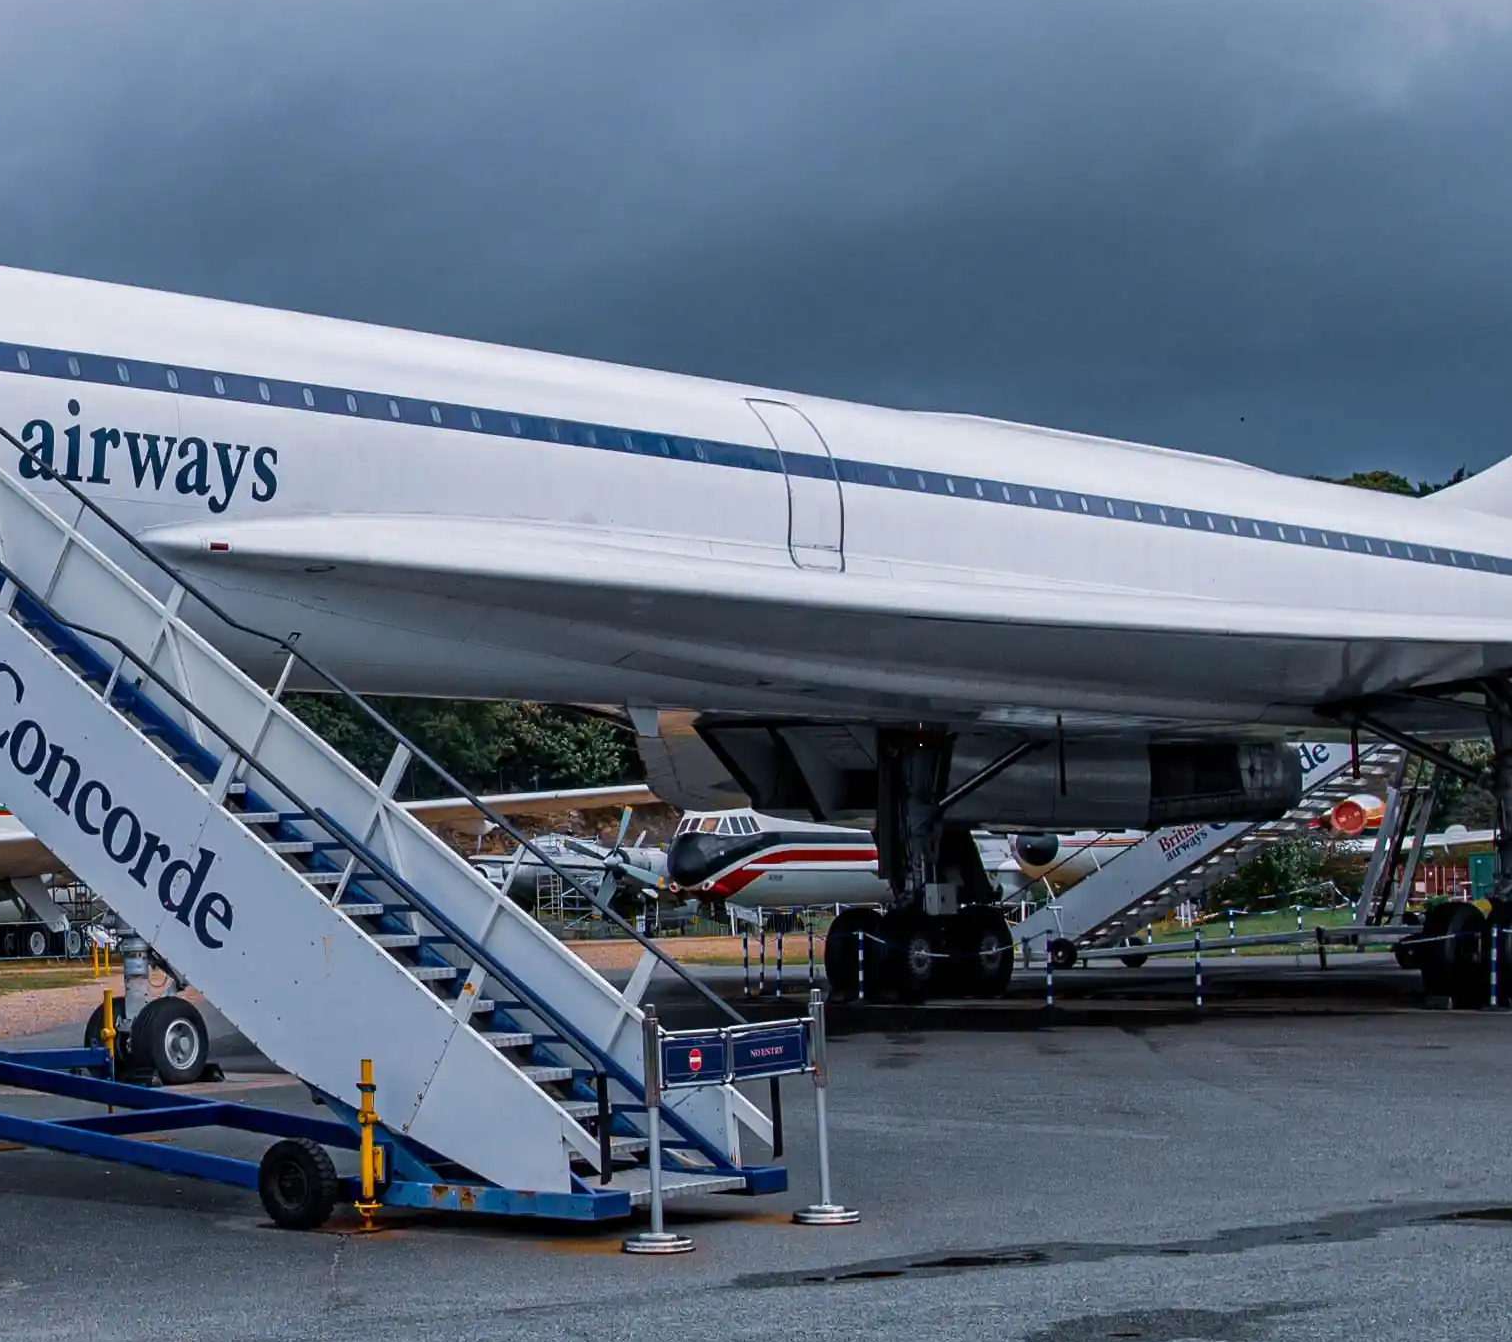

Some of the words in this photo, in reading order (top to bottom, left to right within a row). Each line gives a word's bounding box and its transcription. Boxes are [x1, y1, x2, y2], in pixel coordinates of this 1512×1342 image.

[18, 399, 278, 514] airways
[1165, 829, 1208, 863] airways
[750, 1049, 761, 1058] NO
[761, 1046, 784, 1056] ENTRY
